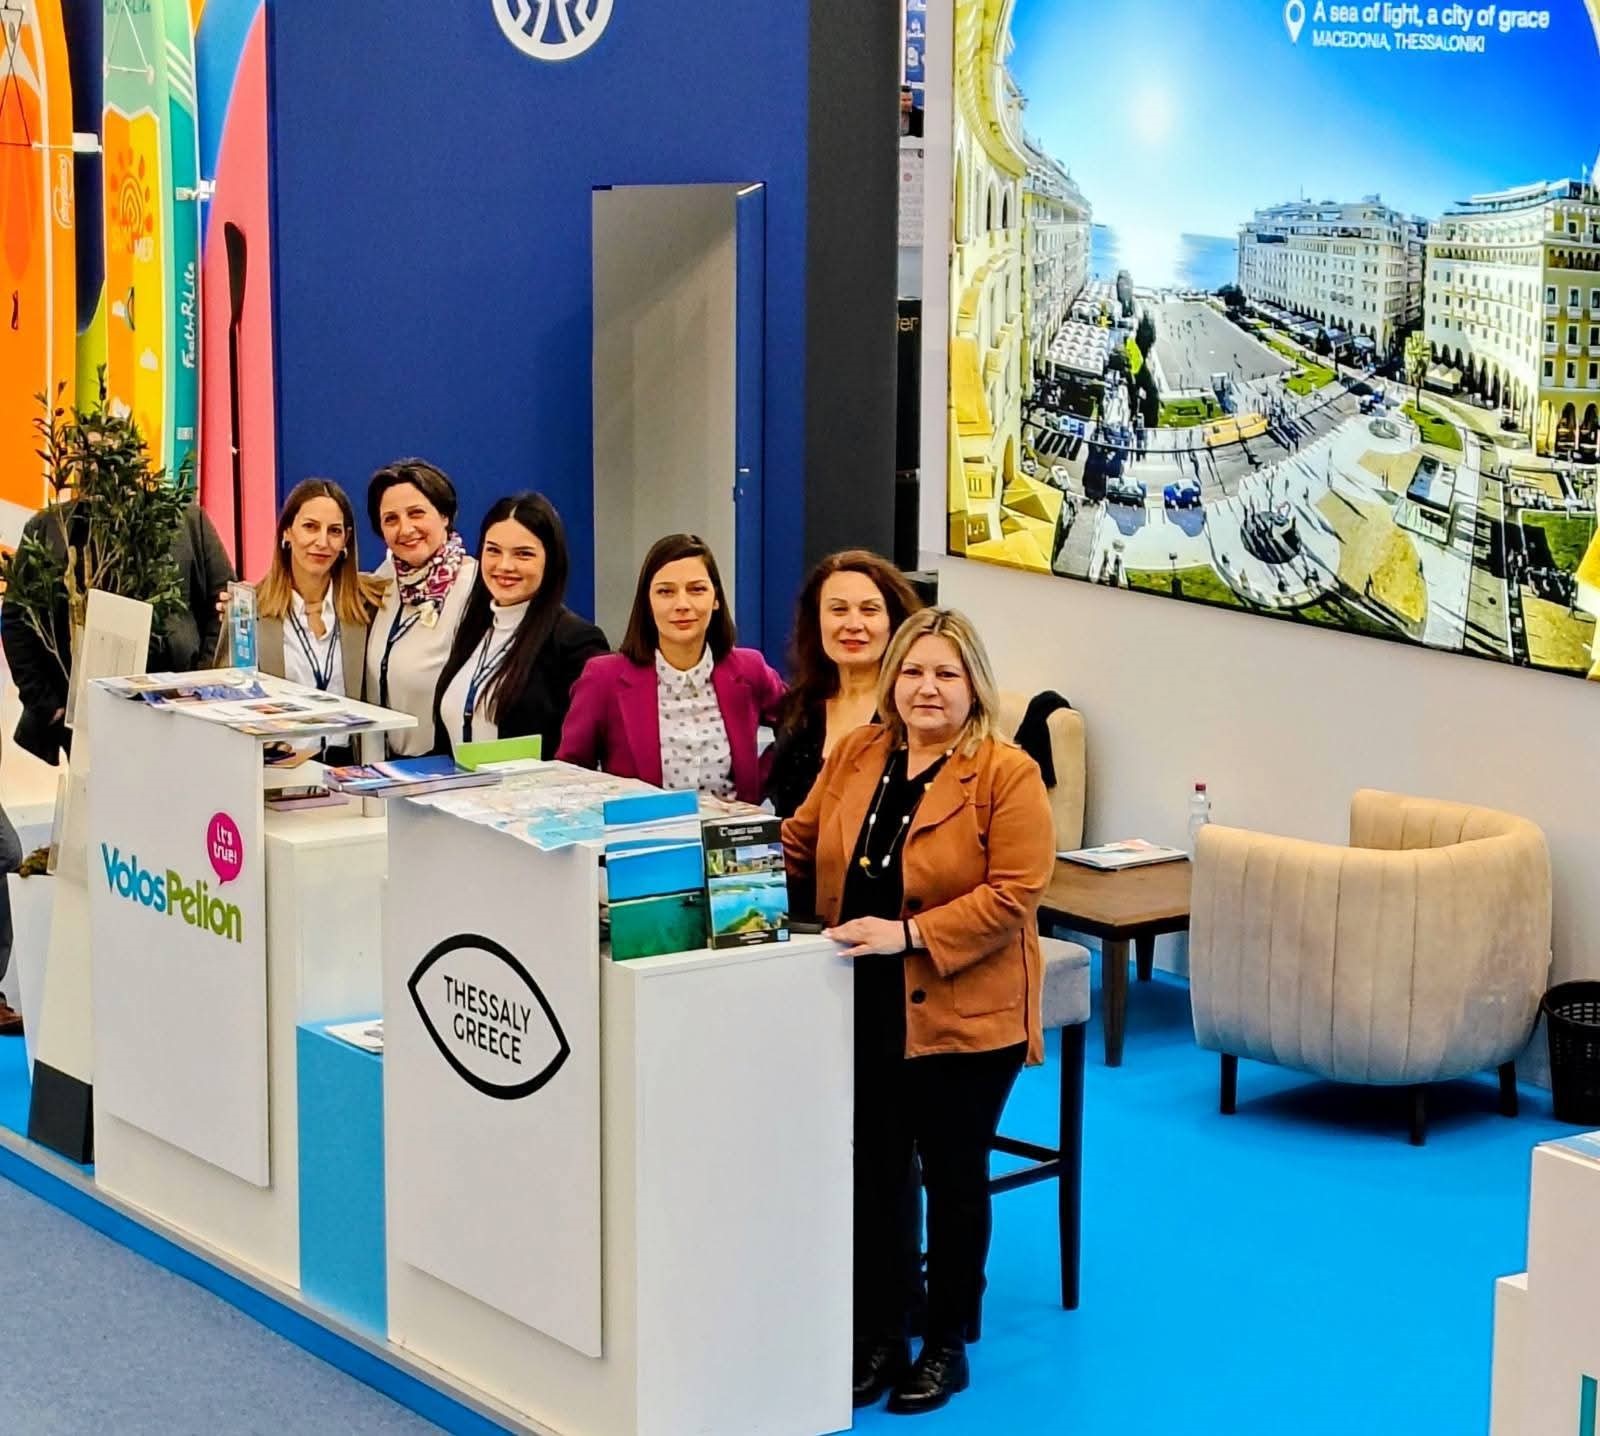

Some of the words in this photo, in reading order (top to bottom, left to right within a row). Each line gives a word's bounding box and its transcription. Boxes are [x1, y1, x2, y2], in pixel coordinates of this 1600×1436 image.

[1312, 29, 1391, 51] MACEDONIA,
[1394, 32, 1485, 53] THESSALONIKI
[1313, 0, 1327, 22] A
[1330, 5, 1359, 22] sea
[1362, 2, 1380, 22] of
[1383, 2, 1423, 29] light,
[1427, 8, 1438, 25] a
[1442, 3, 1474, 32] city
[1477, 4, 1496, 26] of
[1498, 10, 1550, 33] grace
[101, 842, 242, 944] VolosPelion
[443, 975, 531, 1034] THESSALY
[453, 1012, 522, 1064] GREECE
